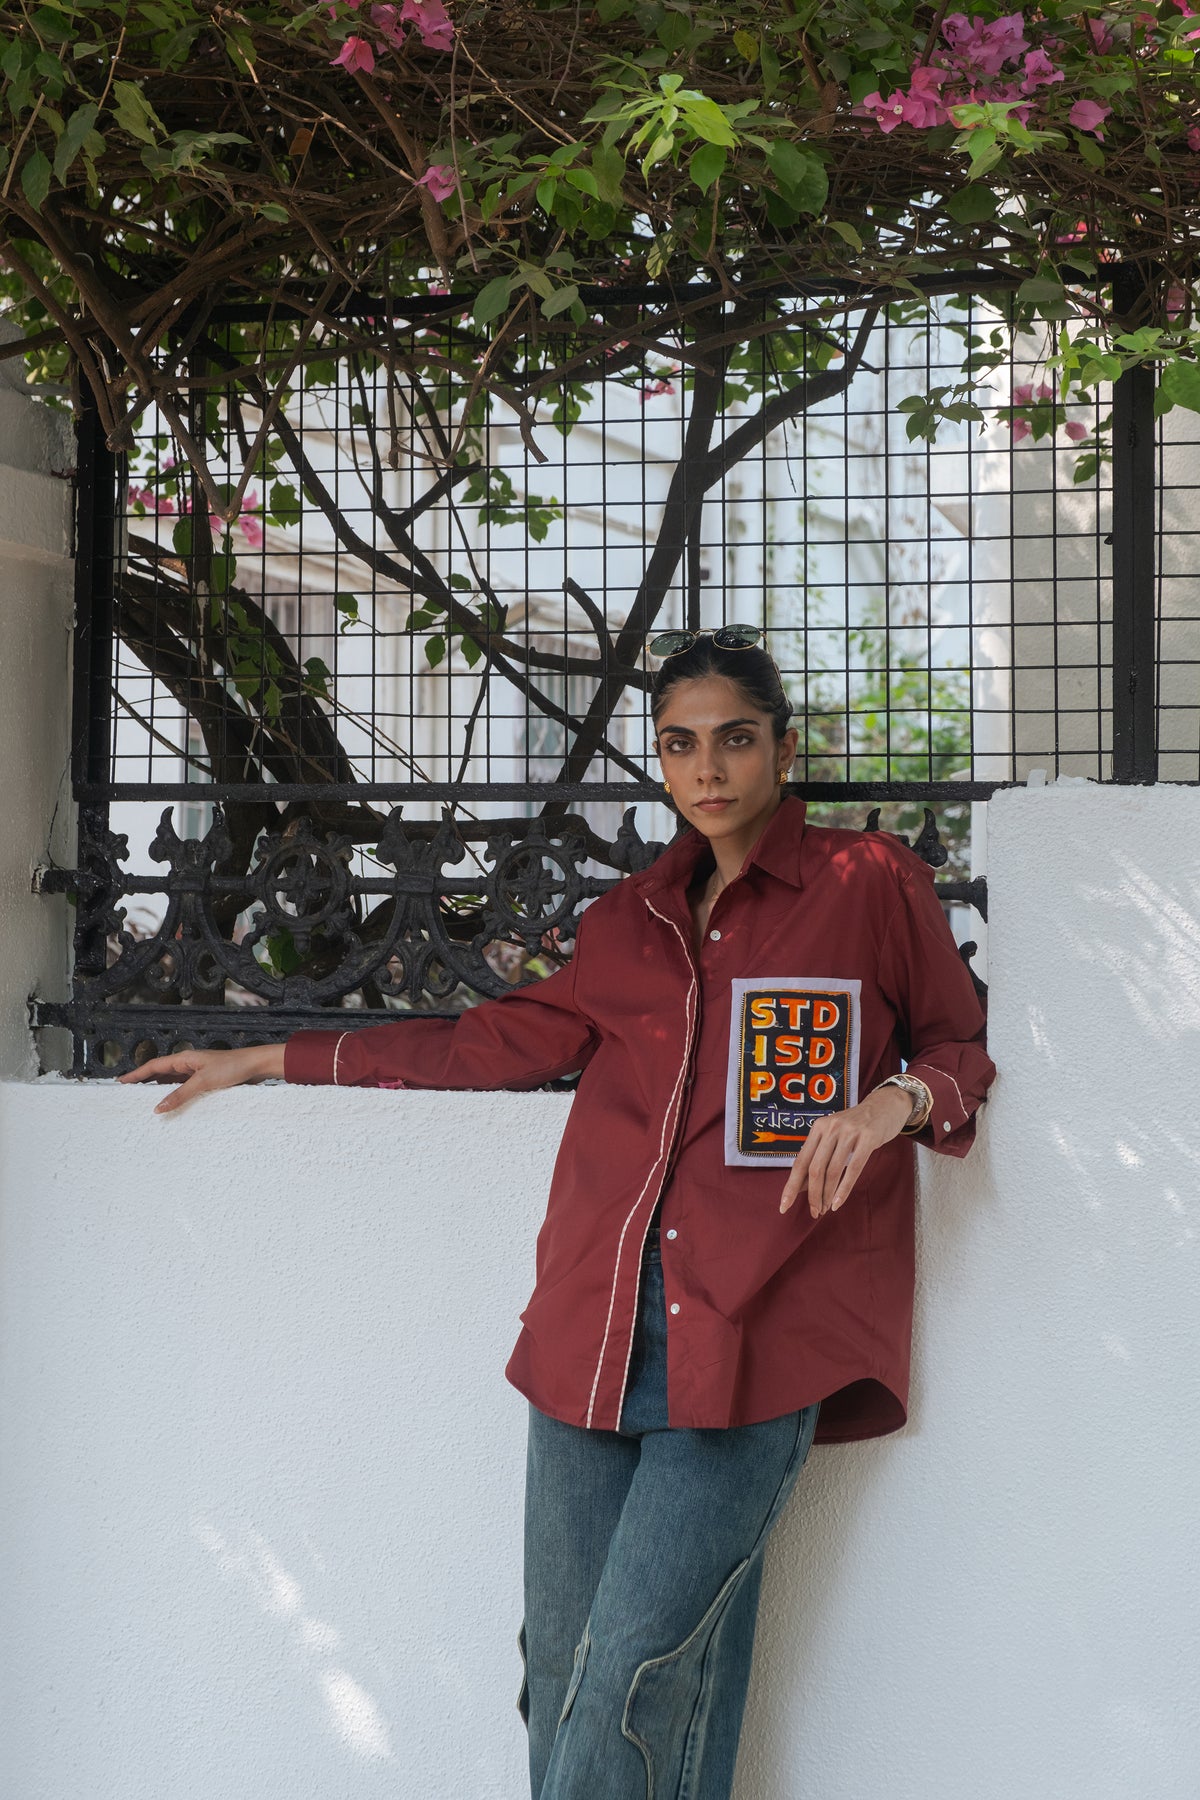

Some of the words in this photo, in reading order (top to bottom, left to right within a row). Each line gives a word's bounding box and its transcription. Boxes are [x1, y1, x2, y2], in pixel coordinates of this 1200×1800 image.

[750, 997, 840, 1031] STD
[754, 1035, 836, 1068] ISD
[750, 1071, 837, 1104] PCO
